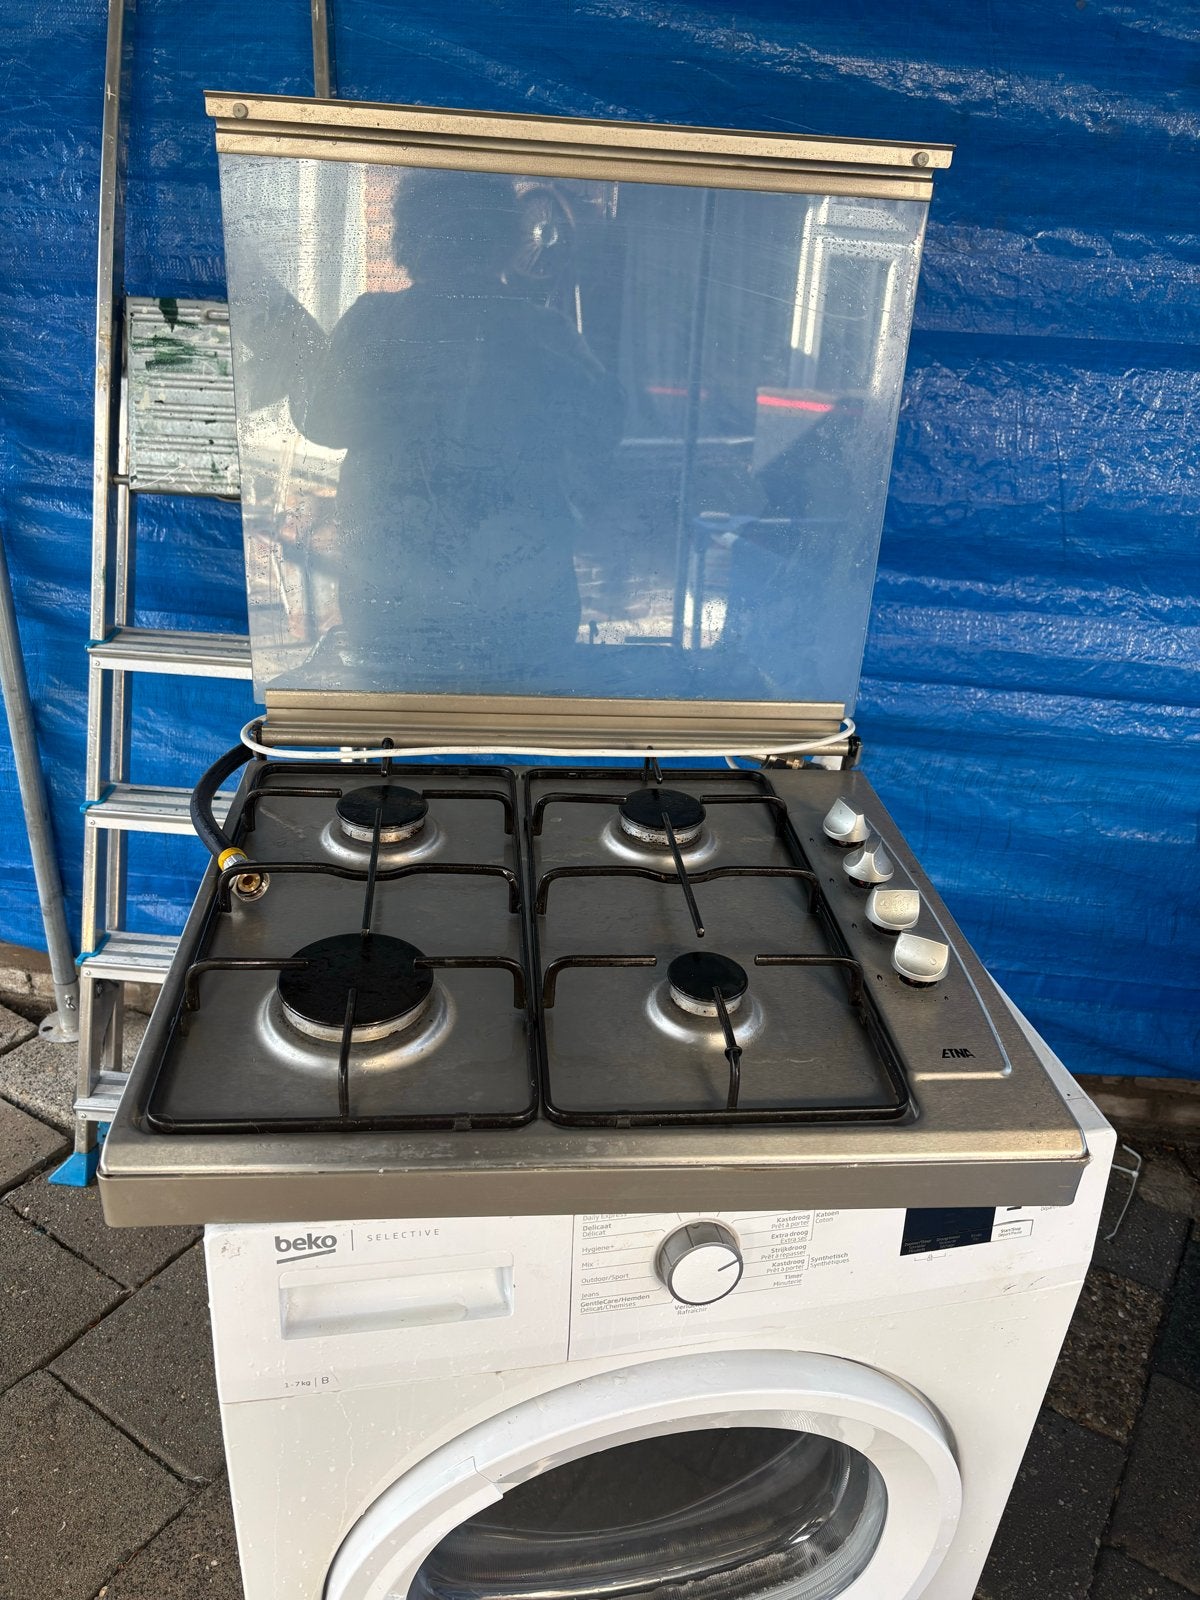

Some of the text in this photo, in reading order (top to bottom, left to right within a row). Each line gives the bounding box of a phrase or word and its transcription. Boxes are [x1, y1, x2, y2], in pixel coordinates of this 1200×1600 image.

[942, 1048, 976, 1058] ETNA
[776, 1214, 811, 1223] Kastdroog
[816, 1210, 840, 1218] Katoen
[582, 1223, 612, 1231] Delicaat
[790, 1220, 809, 1229] porter
[367, 1228, 440, 1241] SELECTIVE
[771, 1230, 809, 1239] Extra droog
[274, 1233, 337, 1252] beko
[771, 1244, 807, 1254] Strijkdroog
[780, 1250, 805, 1259] repasser
[810, 1252, 848, 1262] Synthetisch
[772, 1259, 805, 1267] Kastdroog
[785, 1264, 805, 1273] porter
[581, 1273, 629, 1284] Outdoor/Sport
[581, 1291, 600, 1299] Jeans
[580, 1294, 650, 1307] GentleCare/Hemden
[321, 1376, 329, 1384] B
